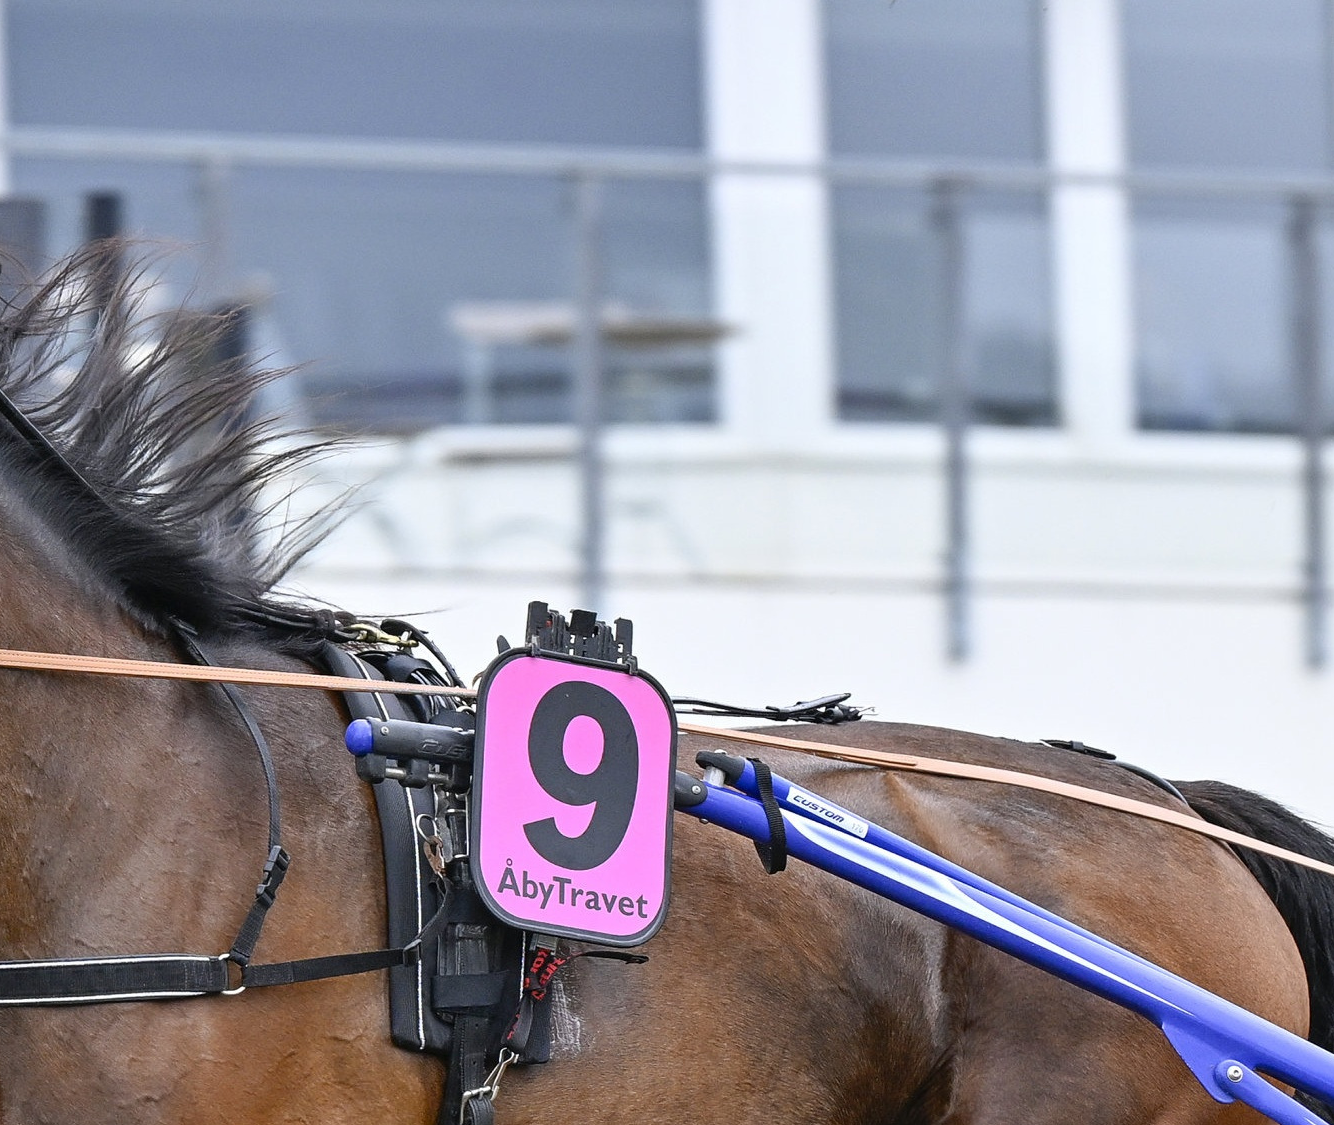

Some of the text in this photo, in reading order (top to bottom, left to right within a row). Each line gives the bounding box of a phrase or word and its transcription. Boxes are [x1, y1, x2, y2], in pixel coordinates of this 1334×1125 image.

[523, 681, 639, 871] 9
[793, 794, 845, 823] CUSTOM
[497, 858, 648, 919] ÅbyTravet
